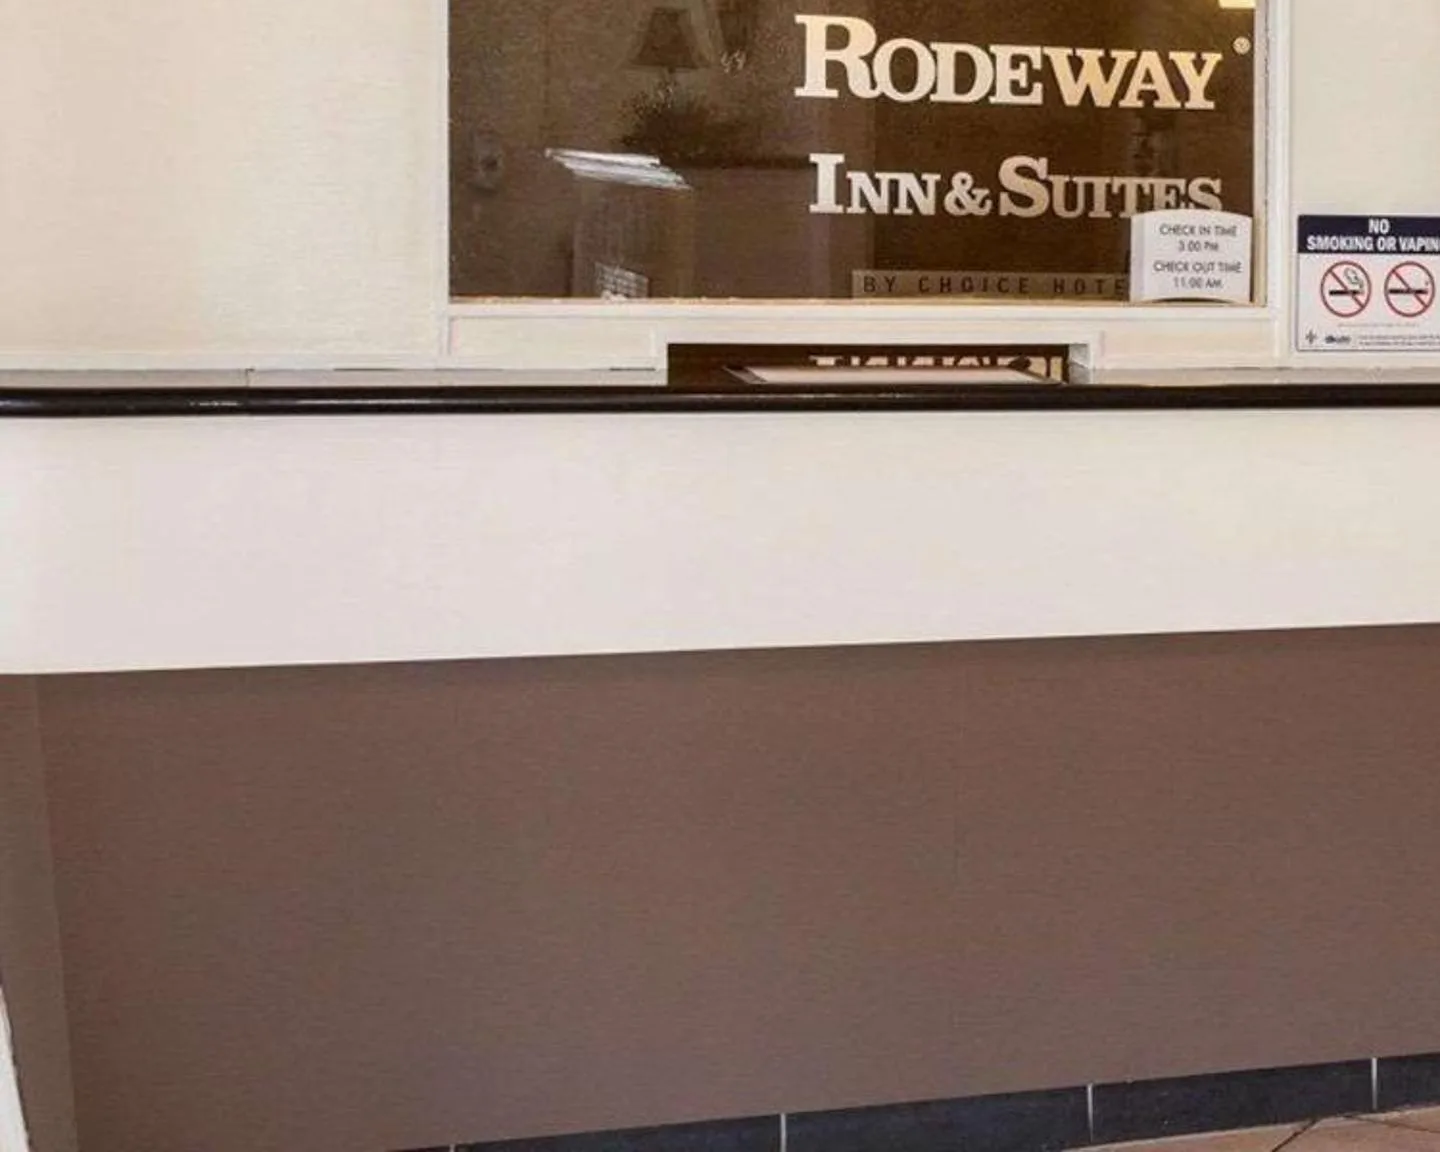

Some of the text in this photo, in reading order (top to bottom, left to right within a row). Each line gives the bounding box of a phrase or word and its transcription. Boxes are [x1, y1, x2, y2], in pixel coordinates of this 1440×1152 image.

[794, 14, 1223, 110] RODEWAY
[1159, 224, 1237, 236] CHECK IN TIME
[1368, 218, 1390, 235] NO
[1306, 235, 1373, 251] SMOKING
[1376, 235, 1397, 251] OR
[1153, 260, 1242, 273] CHECK OUT TIME
[863, 275, 898, 293] BY
[918, 276, 1029, 294] CHOICE
